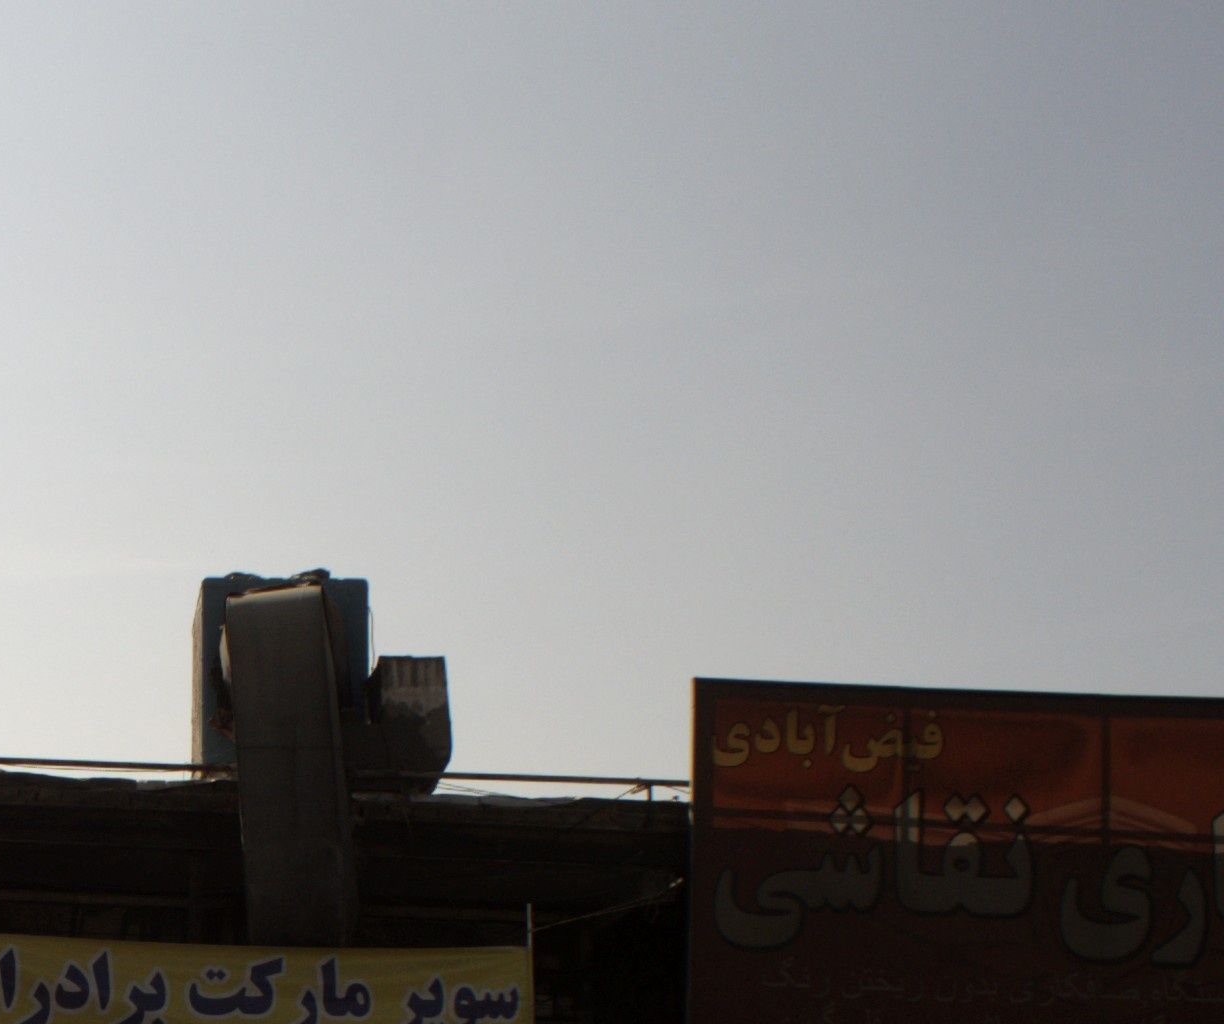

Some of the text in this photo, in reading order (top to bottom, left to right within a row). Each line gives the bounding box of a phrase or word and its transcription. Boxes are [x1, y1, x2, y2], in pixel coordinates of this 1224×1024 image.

[711, 704, 945, 774] فیض آبادی
[712, 783, 1035, 954] نقاشی
